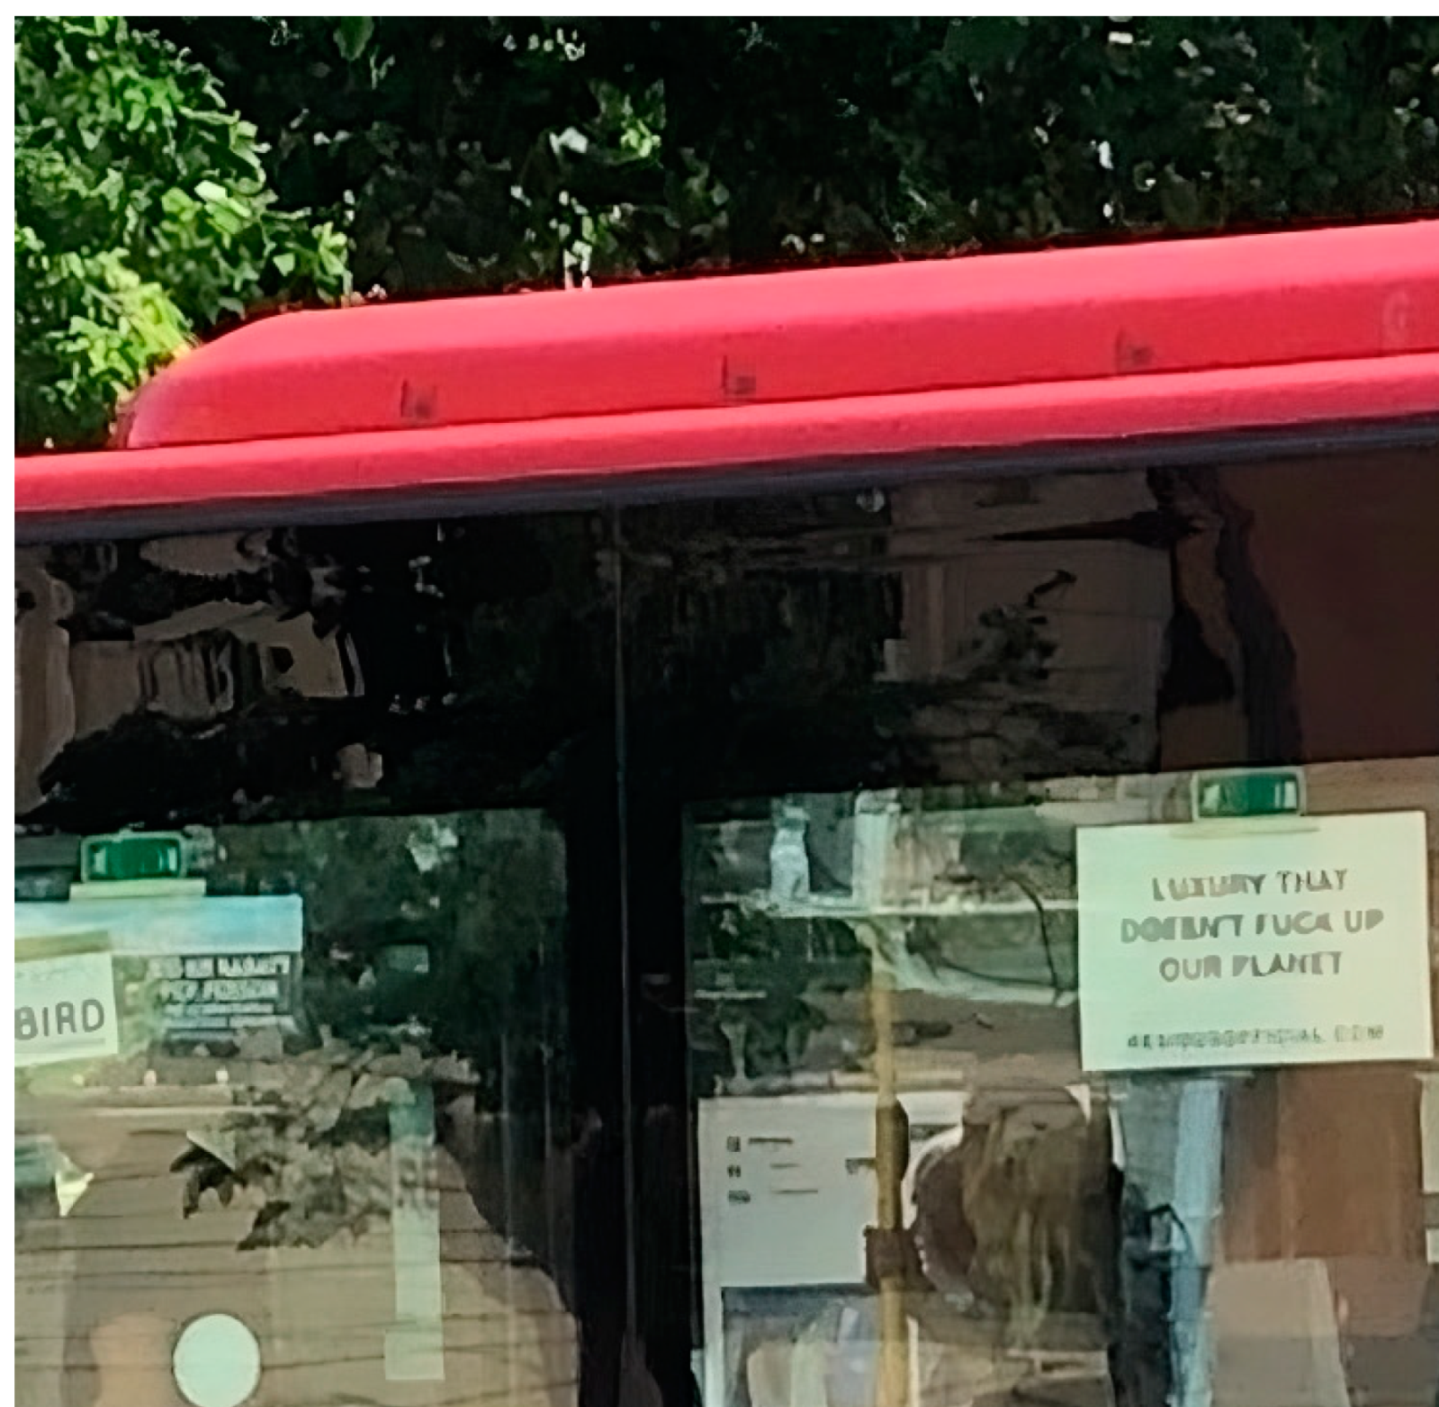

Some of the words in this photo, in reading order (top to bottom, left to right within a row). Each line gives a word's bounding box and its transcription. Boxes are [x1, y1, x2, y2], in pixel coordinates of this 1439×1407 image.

[1152, 873, 1267, 902] LUXURY
[1276, 868, 1348, 894] THAT
[1344, 908, 1385, 934] UP
[1159, 954, 1222, 983] OUR
[1232, 951, 1343, 978] PLANET
[14, 998, 105, 1041] BIRD
